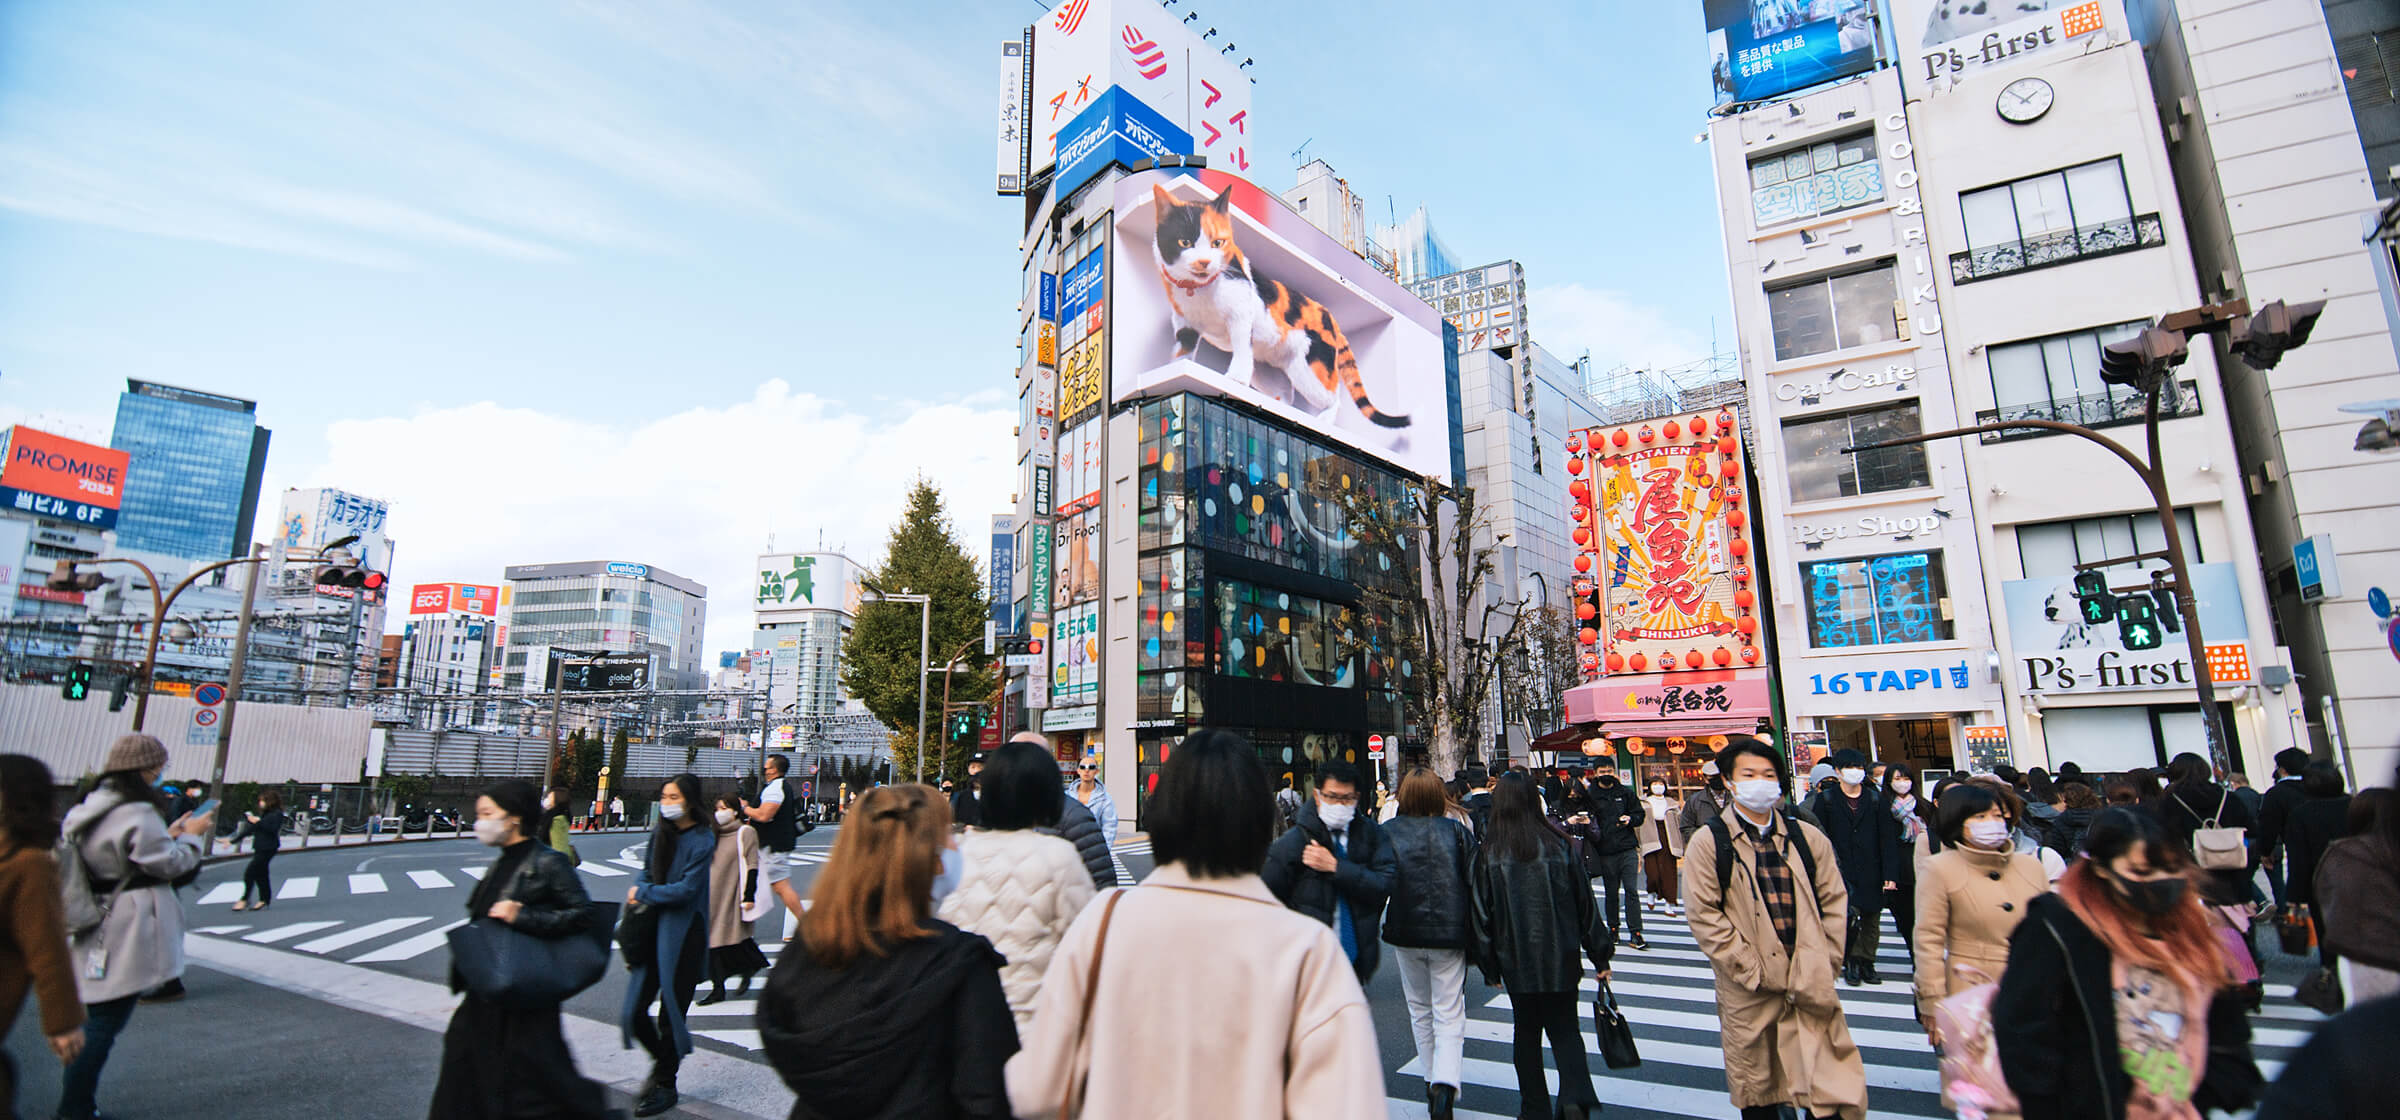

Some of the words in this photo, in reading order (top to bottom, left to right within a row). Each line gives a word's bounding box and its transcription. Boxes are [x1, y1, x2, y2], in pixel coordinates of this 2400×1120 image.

[1737, 34, 1806, 65] 高品質な製品
[1740, 58, 1774, 78] を提供
[1059, 114, 1110, 170] アパマンショップ
[1837, 365, 1918, 392] Cafe
[16, 445, 119, 485] PROMISE
[1624, 446, 1692, 463] YATAIEN
[78, 478, 115, 497] プロミス
[15, 490, 69, 517] 当ビル
[76, 505, 104, 523] 6F
[332, 494, 387, 530] カラオケ
[1057, 533, 1070, 548] Dr
[1074, 522, 1101, 542] Foot
[1630, 467, 1708, 617] 屋台苑
[1792, 520, 1849, 545] Pet
[1857, 514, 1941, 538] Shop
[610, 562, 644, 574] welcia
[415, 595, 443, 608] ECC
[1057, 612, 1097, 641] 宝石広場
[1639, 625, 1709, 639] SHINJUKU
[1809, 672, 1851, 695] 16
[1855, 667, 1943, 692] TAPI
[1658, 684, 1733, 717] 屋台苑
